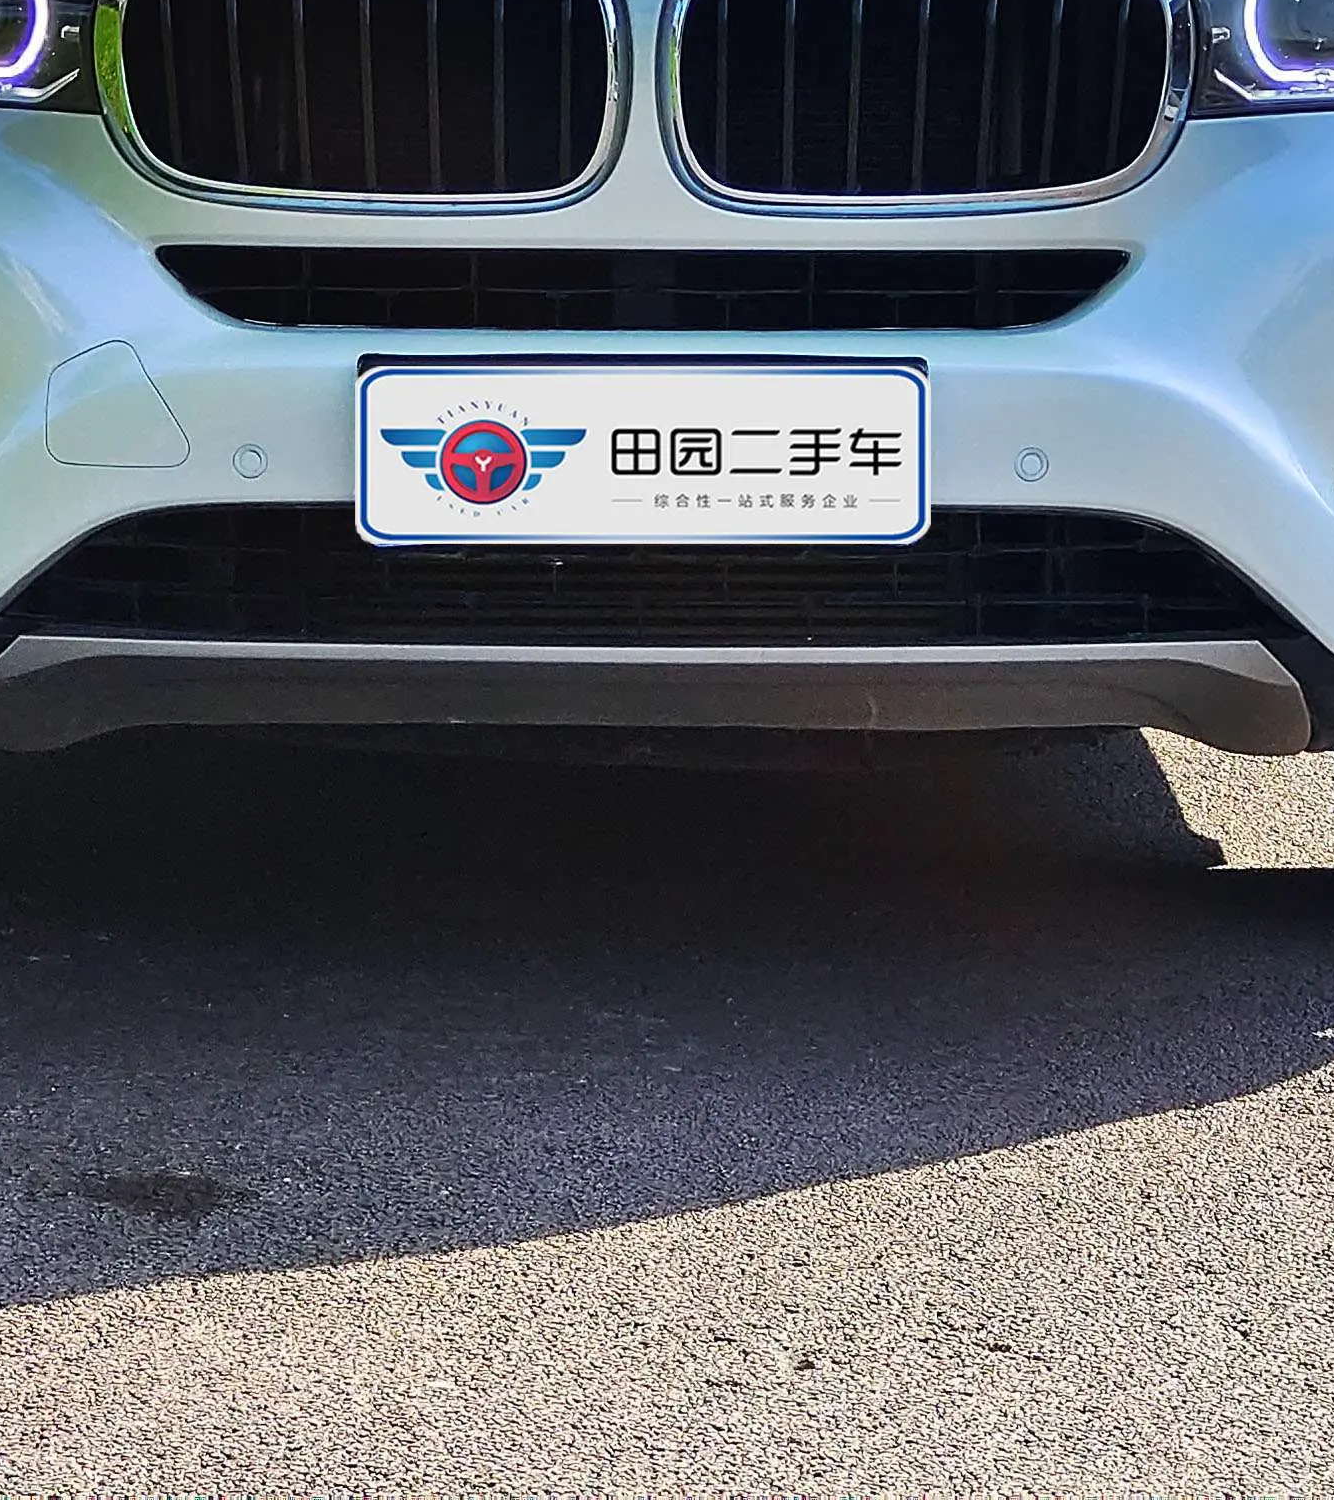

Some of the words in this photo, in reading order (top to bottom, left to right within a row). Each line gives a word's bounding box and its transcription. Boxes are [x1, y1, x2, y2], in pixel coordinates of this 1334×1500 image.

[611, 428, 903, 477] 田园二手车
[653, 493, 858, 509] 综合性一站式服务企业
